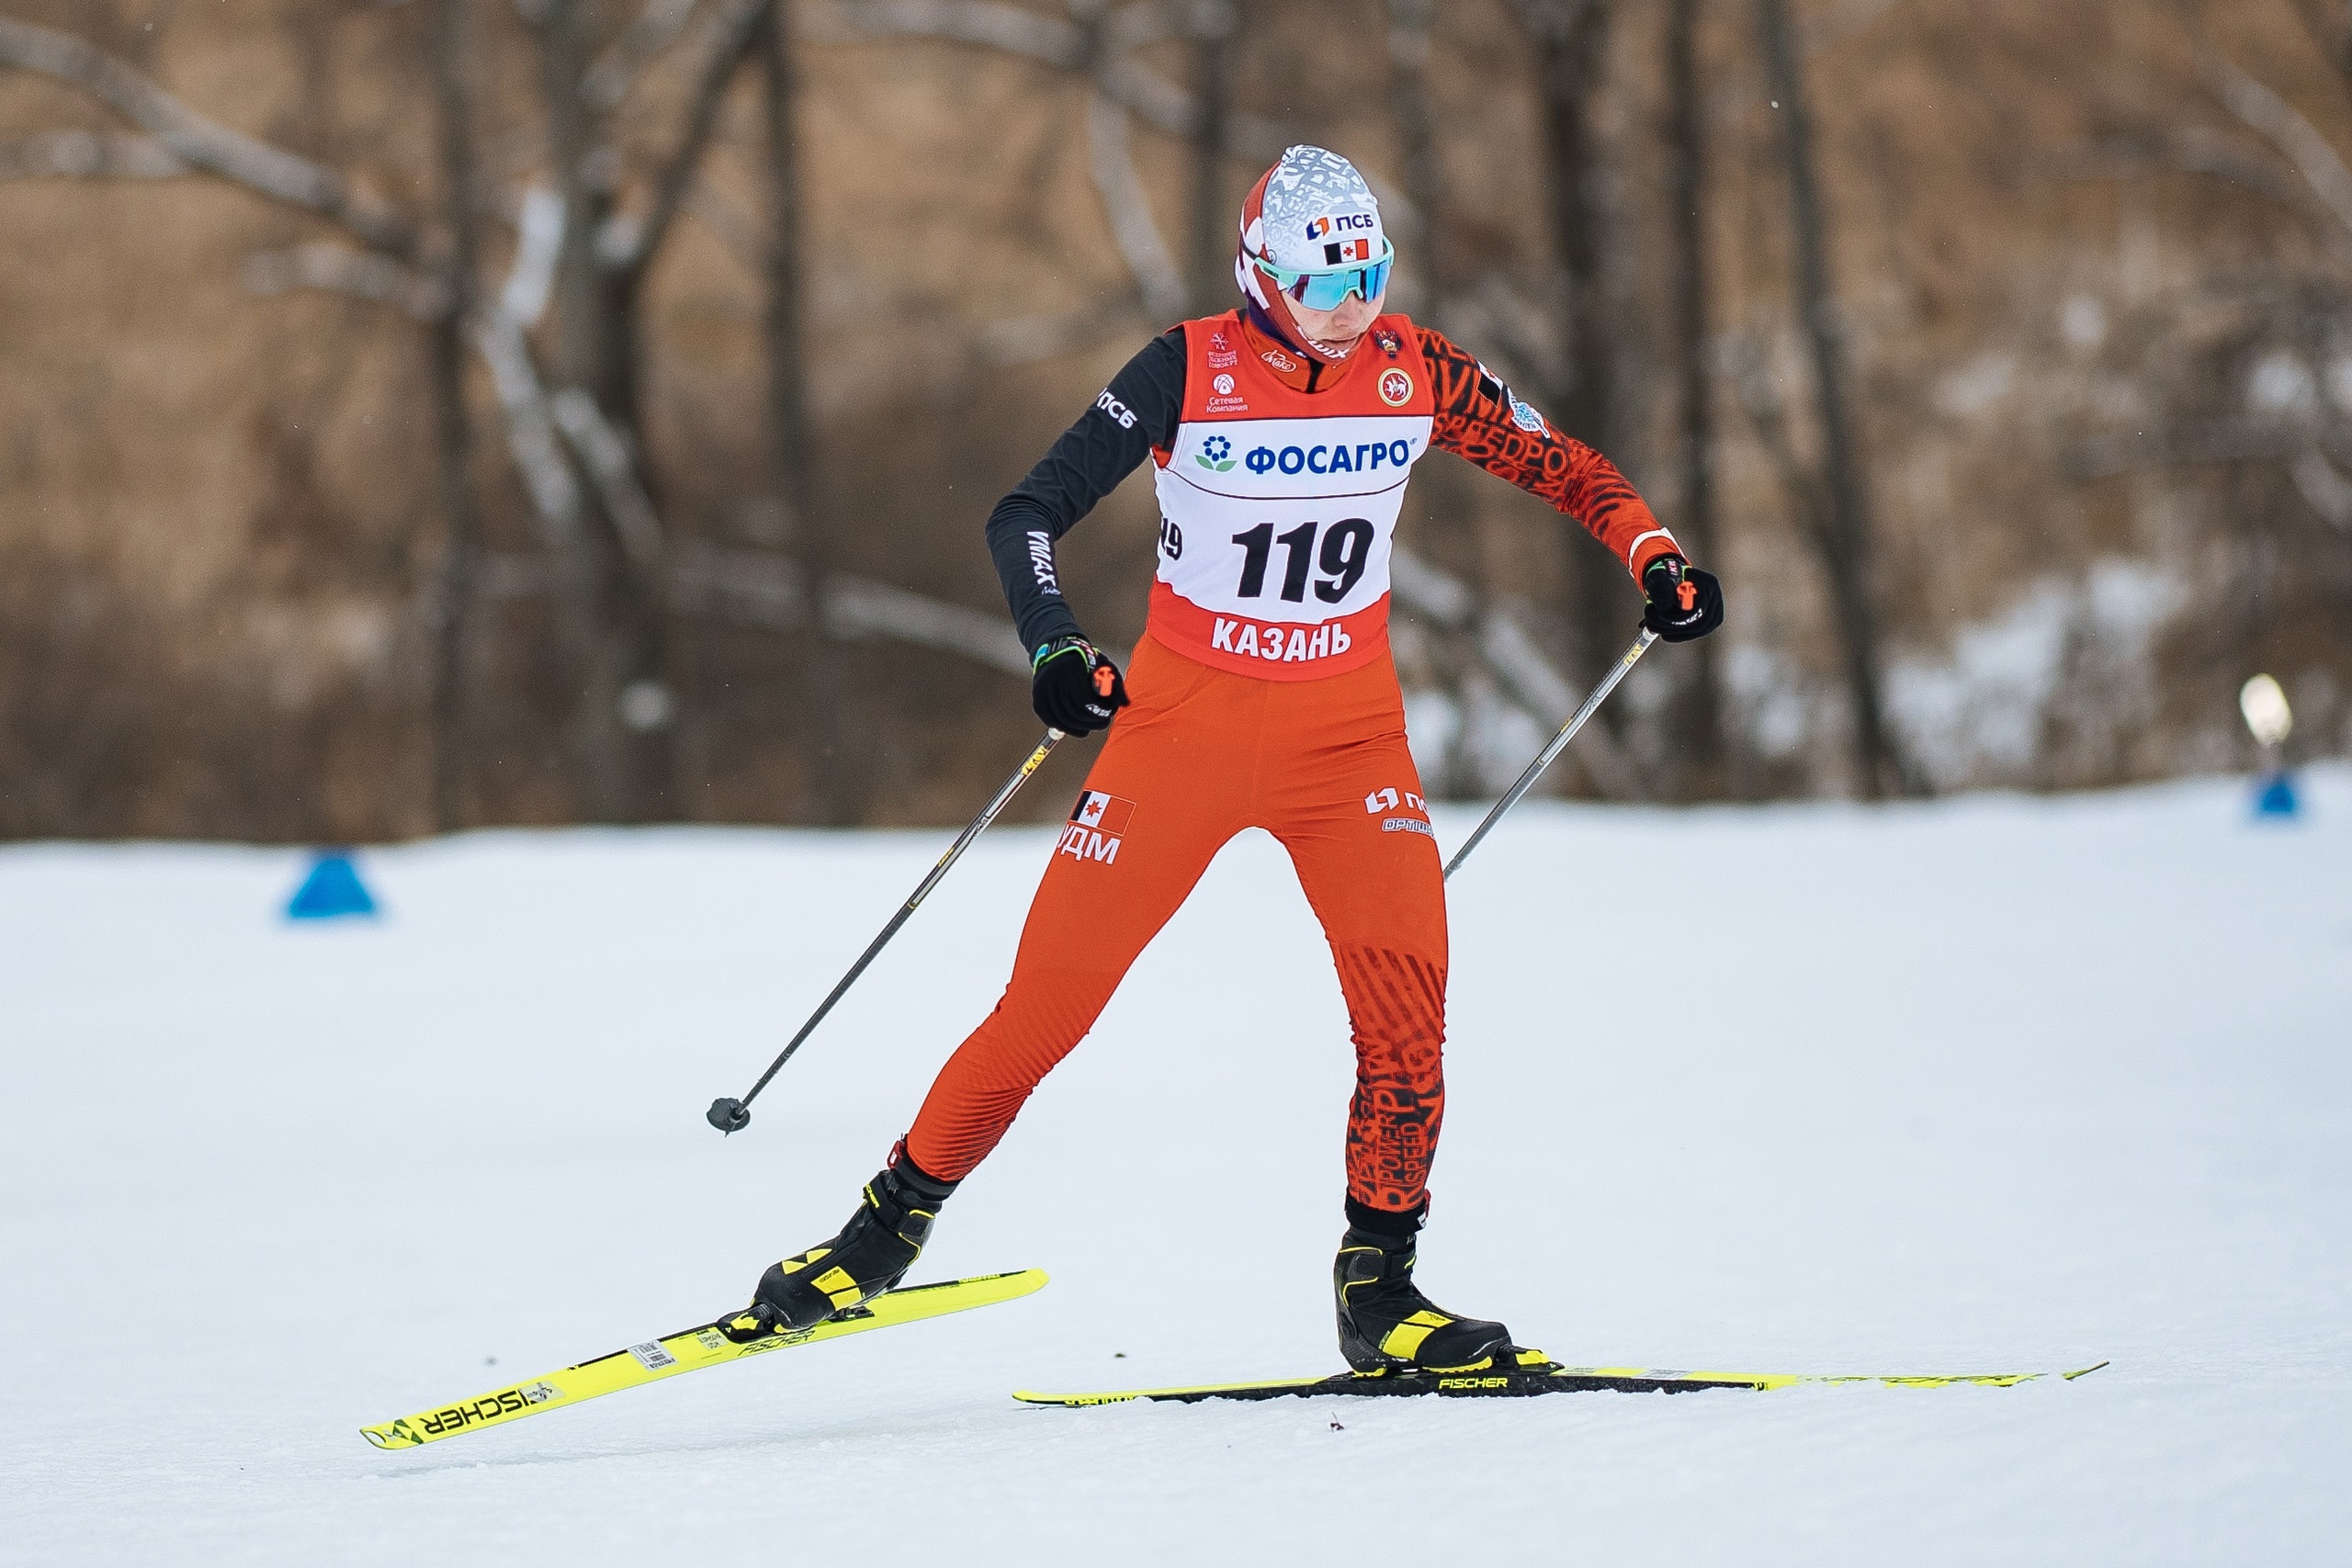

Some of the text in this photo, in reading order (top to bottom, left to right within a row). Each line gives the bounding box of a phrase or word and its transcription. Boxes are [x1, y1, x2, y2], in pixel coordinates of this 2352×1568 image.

[1335, 214, 1374, 231] ПСБ
[1096, 391, 1138, 429] ПСБ
[1206, 404, 1249, 413] Компания
[1209, 397, 1244, 405] Сетевая
[1245, 439, 1409, 475] ФОСАГРО
[1027, 531, 1056, 587] VMAX
[1231, 517, 1374, 604] 119
[1211, 616, 1351, 663] КАЗАНЬ
[1057, 824, 1121, 864] УДМ
[738, 1329, 816, 1357] FISCHER
[1438, 1378, 1509, 1390] FISCHER
